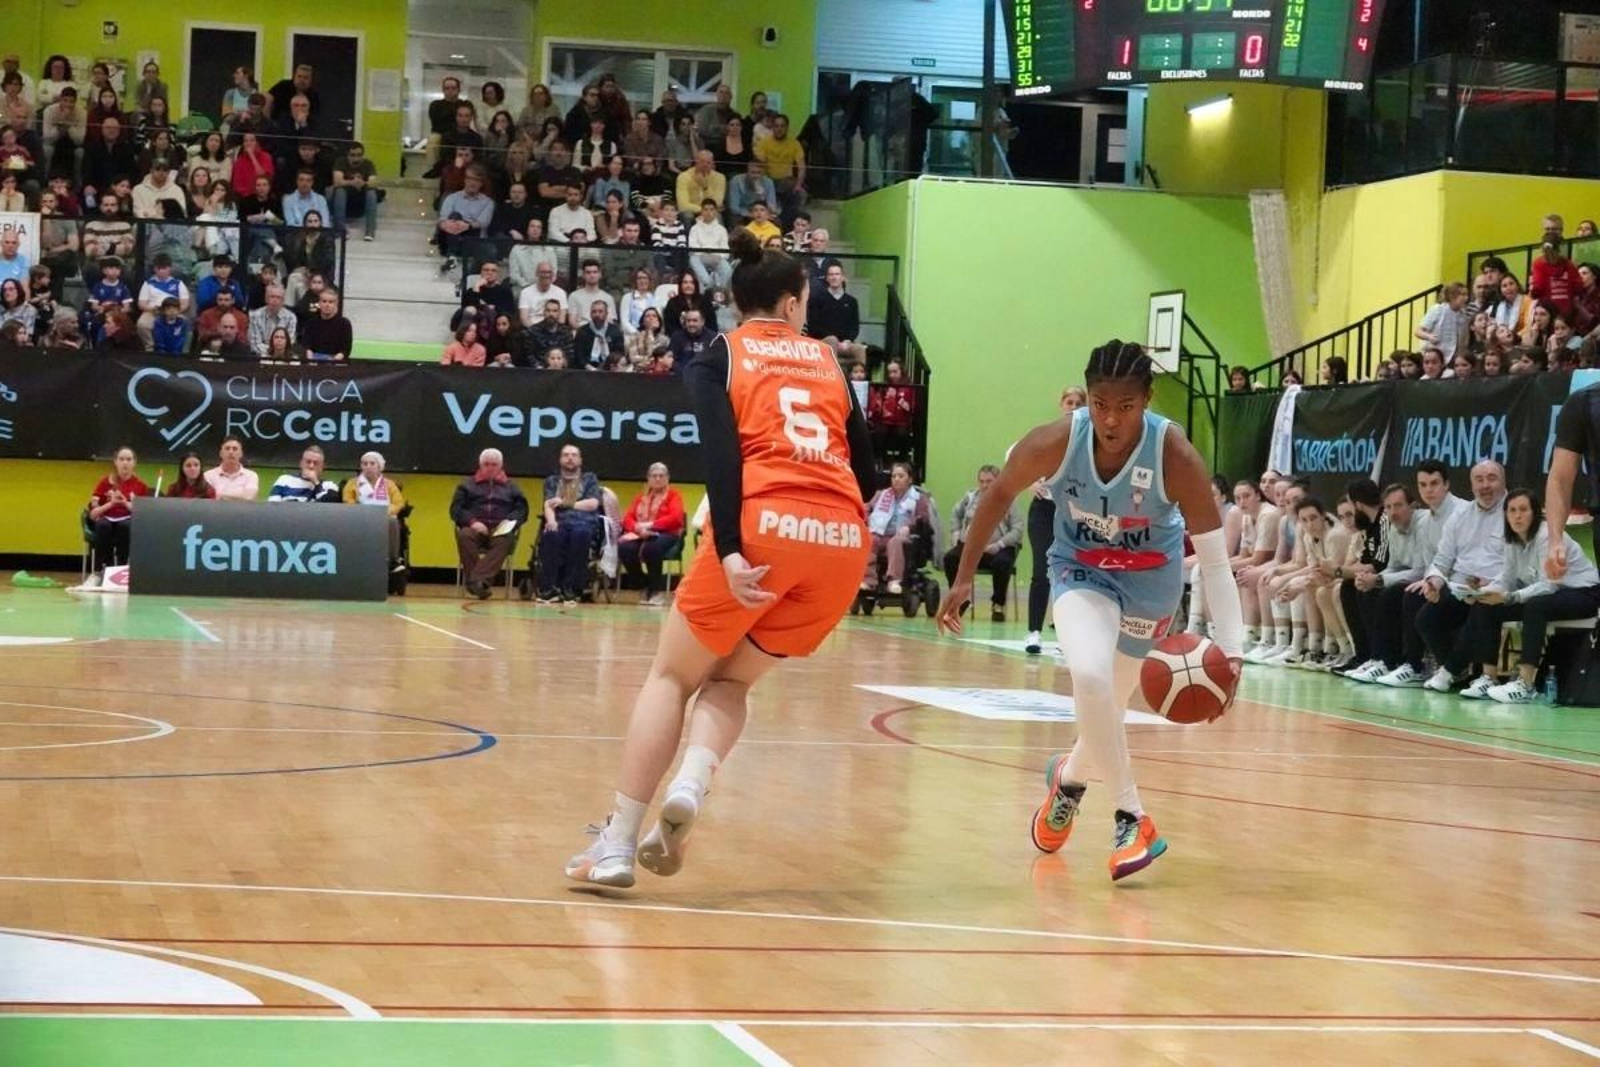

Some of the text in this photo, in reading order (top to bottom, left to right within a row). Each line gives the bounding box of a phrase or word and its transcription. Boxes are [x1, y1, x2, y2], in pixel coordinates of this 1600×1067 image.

[1016, 4, 1031, 16] 14
[1232, 10, 1271, 18] MONDO
[1287, 5, 1303, 17] 14
[1360, 8, 1371, 22] 2
[1016, 18, 1031, 31] 15
[1285, 19, 1302, 32] 21
[1017, 32, 1031, 45] 21
[1283, 33, 1300, 47] 22
[1357, 37, 1368, 51] 4
[1017, 45, 1032, 58] 29
[1123, 40, 1130, 64] 1
[1244, 35, 1263, 64] 0
[1018, 59, 1032, 72] 31
[1018, 73, 1033, 86] 55
[1107, 71, 1132, 80] FALTAS
[1160, 69, 1207, 79] EXCLUSIONES
[1239, 69, 1265, 78] FALTAS
[1015, 84, 1051, 96] MONDO
[1323, 80, 1364, 91] MONDO
[742, 337, 824, 362] BUENAVIDA
[226, 373, 363, 403] CLÍNICA
[225, 407, 391, 443] RCCelta
[442, 392, 701, 447] Vepersa
[779, 387, 829, 451] 6
[1401, 414, 1509, 467] ABANCA
[1100, 496, 1108, 517] 1
[758, 510, 862, 548] PAMESA
[183, 524, 337, 574] femxa
